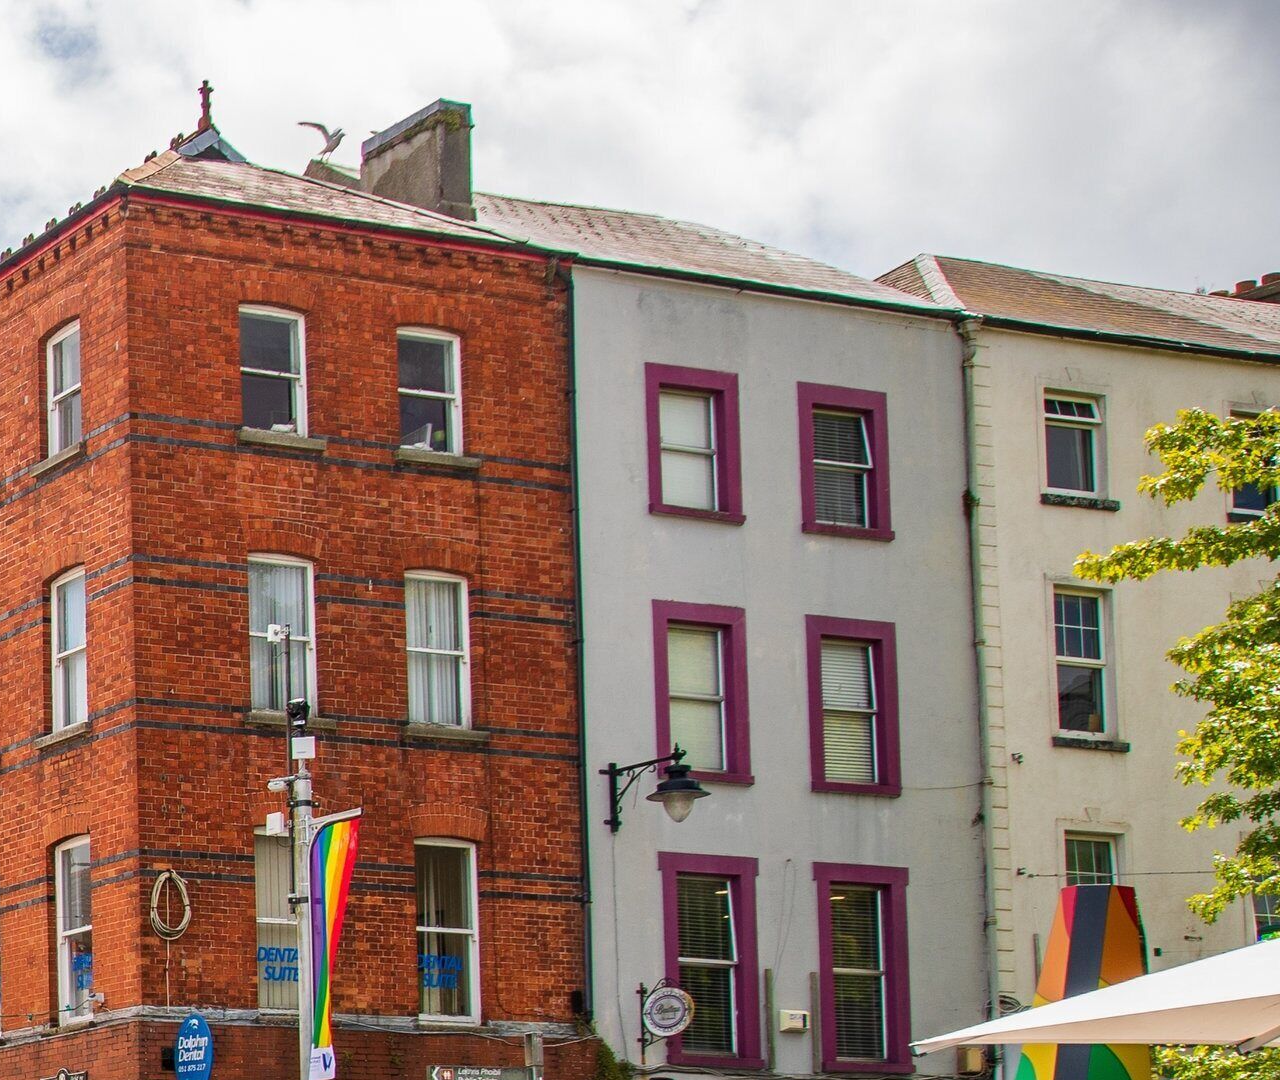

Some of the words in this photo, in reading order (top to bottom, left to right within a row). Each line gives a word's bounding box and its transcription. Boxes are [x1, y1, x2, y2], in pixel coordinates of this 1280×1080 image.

[257, 947, 299, 962] DENTA
[417, 954, 463, 971] DENTAL
[423, 973, 458, 989] SUITE
[178, 1034, 208, 1051] Dolphin
[178, 1047, 205, 1062] Dental
